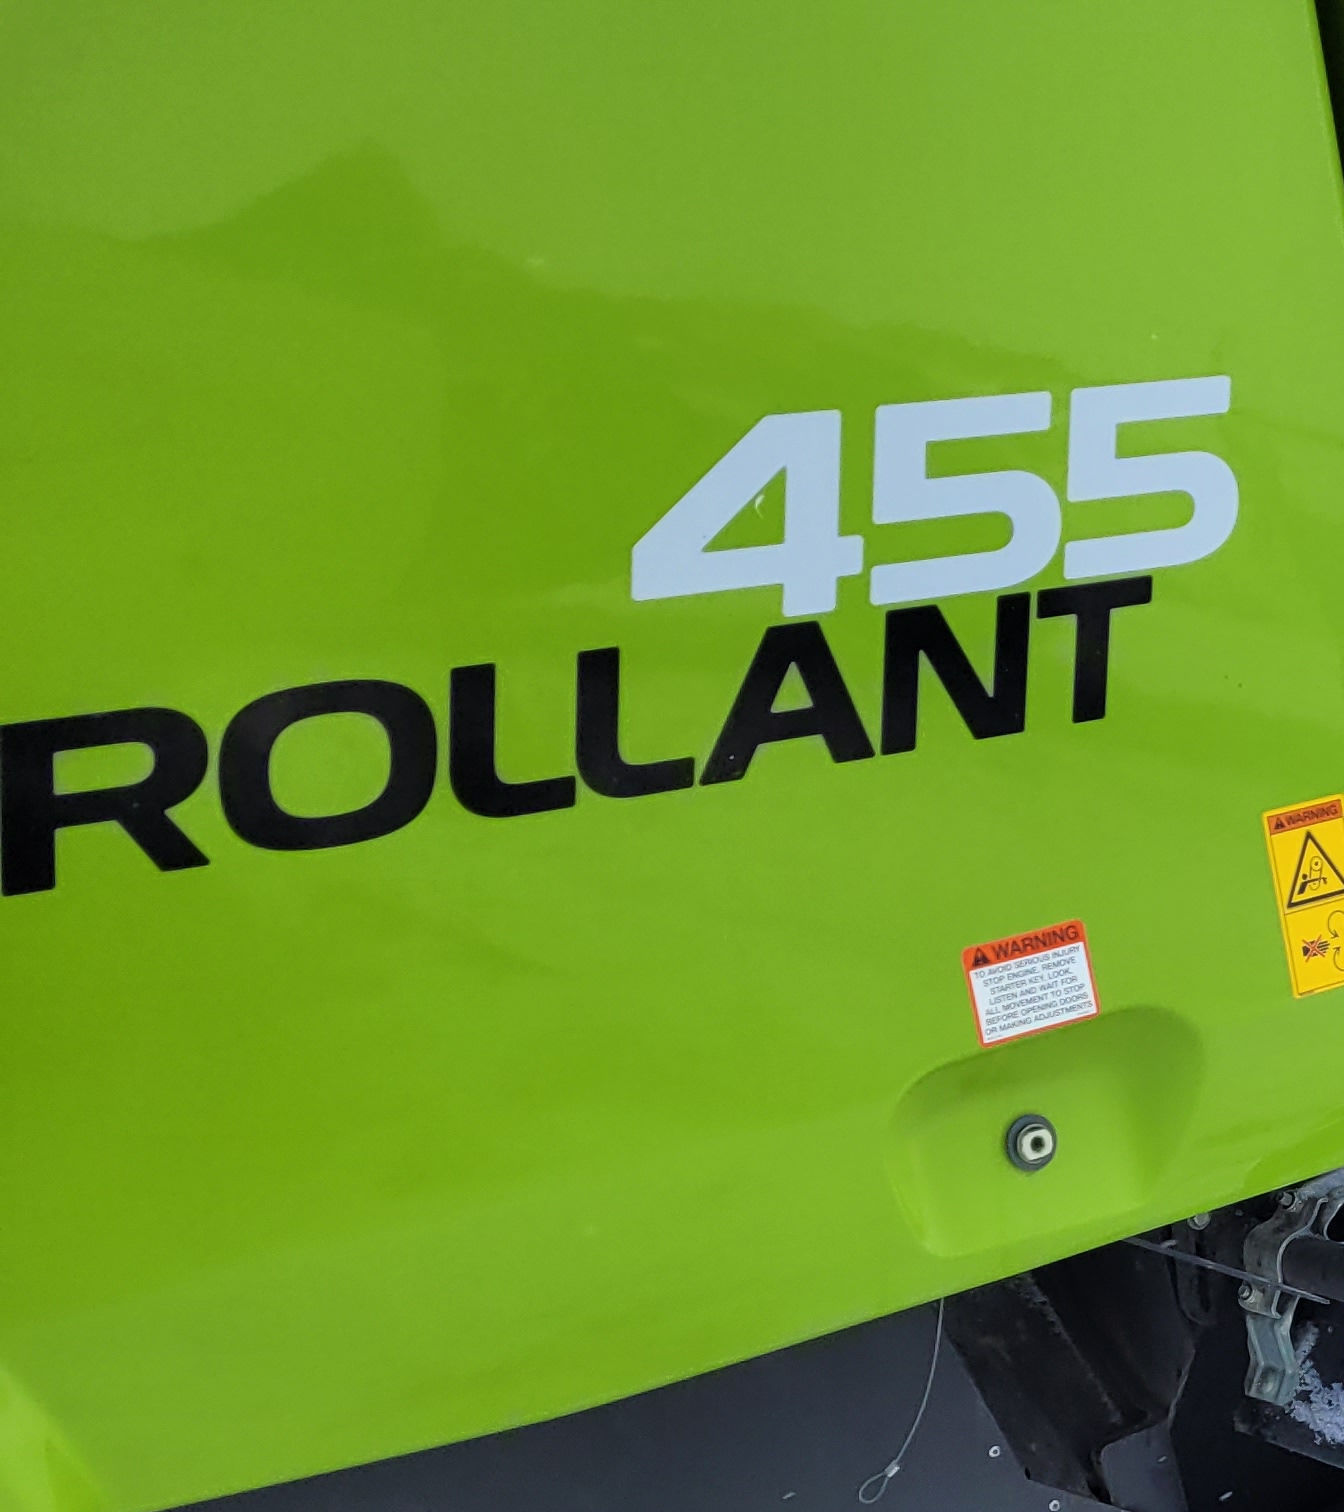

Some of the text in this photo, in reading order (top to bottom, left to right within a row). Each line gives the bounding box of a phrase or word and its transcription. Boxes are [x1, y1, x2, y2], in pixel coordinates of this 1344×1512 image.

[633, 376, 1239, 617] 455
[0, 577, 1153, 895] ROLLANT
[1286, 805, 1338, 825] WARNING
[991, 925, 1078, 960] WARNING
[973, 945, 1080, 978] TO AVOID SERIOUS INJURY
[983, 975, 1005, 987] STOP
[1042, 956, 1076, 970] REMOVE
[985, 1006, 1001, 1016] ALL
[1002, 993, 1049, 1010] MOVEMENT
[1063, 984, 1085, 995] STOP
[989, 976, 1078, 1005] LISTEN AND WAIT FOR
[990, 979, 1027, 995] STARTER
[985, 1026, 998, 1035] OR
[999, 1017, 1032, 1031] MAKING
[1033, 1001, 1093, 1022] ADJUSTMENTS
[986, 991, 1089, 1025] BEFORE OPENING DOORS
